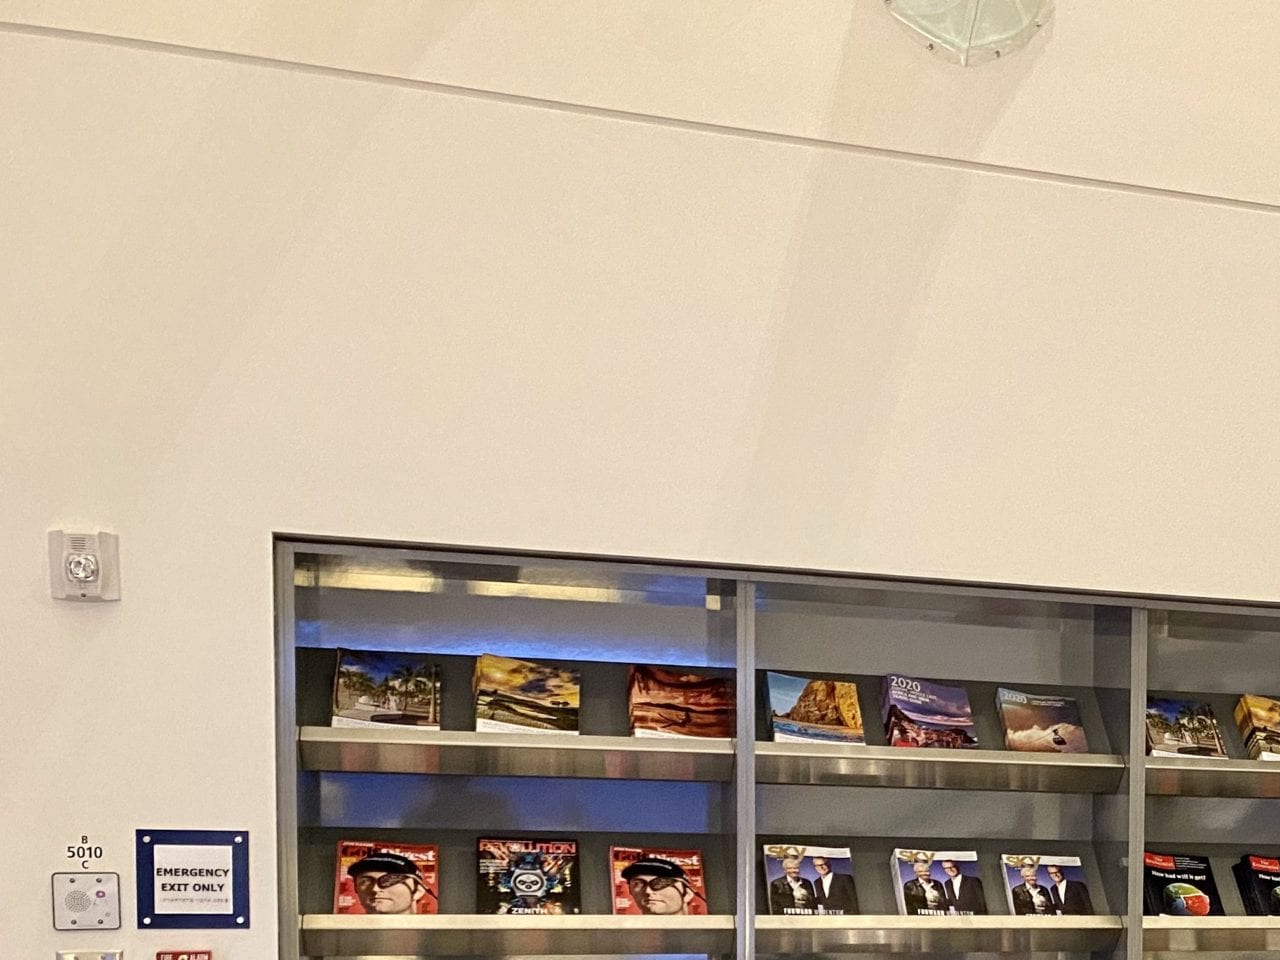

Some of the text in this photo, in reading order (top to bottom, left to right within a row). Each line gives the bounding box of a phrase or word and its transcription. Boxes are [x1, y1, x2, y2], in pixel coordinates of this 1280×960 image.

[890, 676, 920, 692] 2020
[1003, 692, 1027, 704] 2020
[81, 836, 88, 844] B
[67, 846, 102, 859] 5010
[82, 860, 88, 870] C
[156, 868, 230, 878] EMERGENCY
[161, 883, 225, 892] EXIT ONLY
